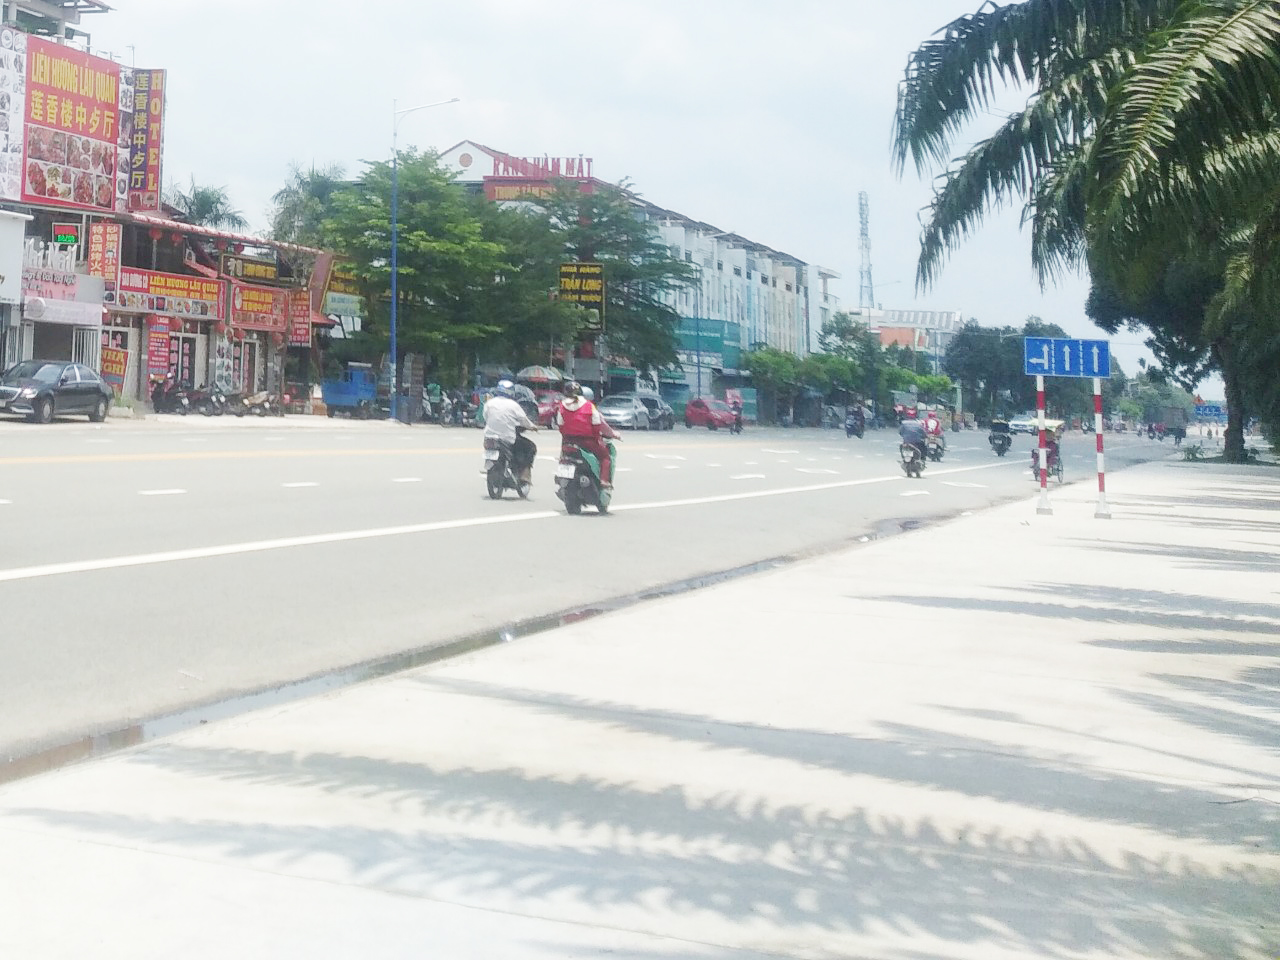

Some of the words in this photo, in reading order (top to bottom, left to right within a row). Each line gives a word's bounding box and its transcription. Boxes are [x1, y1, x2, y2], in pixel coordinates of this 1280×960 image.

[31, 48, 50, 84] LIÊN
[95, 69, 116, 105] QUÁN
[147, 72, 163, 191] HOTEL
